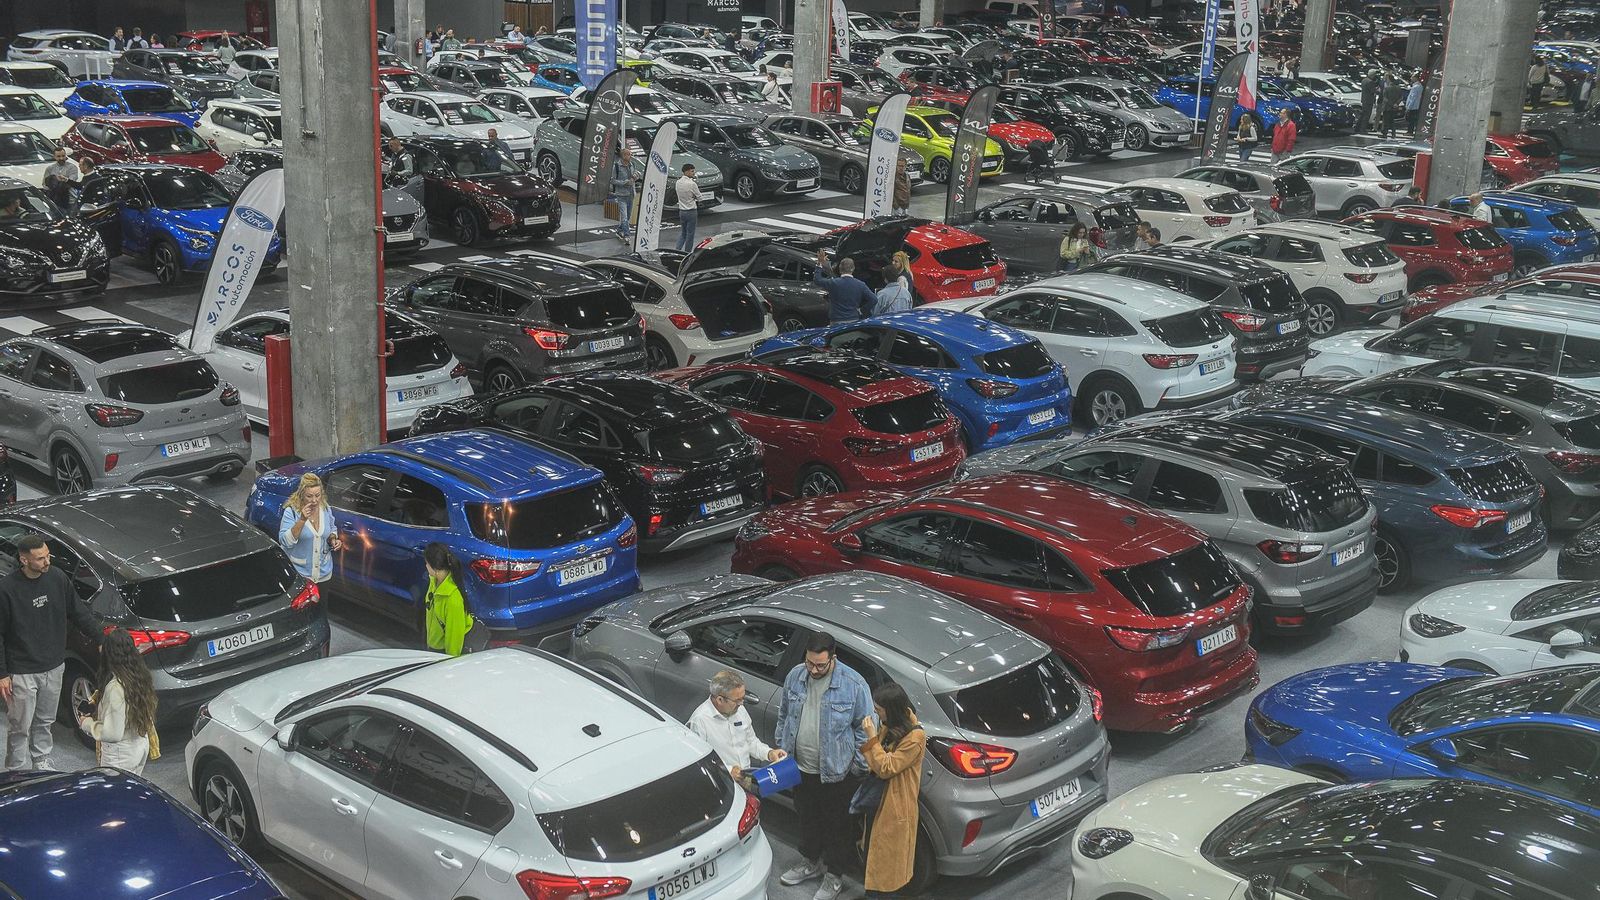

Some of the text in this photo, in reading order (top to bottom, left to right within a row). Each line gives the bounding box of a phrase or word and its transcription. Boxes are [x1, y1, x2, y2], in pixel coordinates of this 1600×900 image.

[597, 96, 624, 109] NISSAN
[1422, 88, 1440, 134] MARCOS
[880, 128, 894, 140] Ford
[1208, 107, 1226, 158] MARCOS
[586, 124, 607, 184] MARCOS
[870, 156, 885, 220] MARCOS
[956, 143, 972, 203] MARCOS
[241, 209, 267, 229] Ford
[640, 182, 656, 249] MARCOS
[207, 243, 245, 326] MARCOS
[230, 250, 256, 306] automoción
[167, 438, 207, 454] 8819 MLF
[706, 499, 725, 511] 5486
[563, 566, 586, 580] 0686
[217, 626, 270, 651] 4060 LDY
[1203, 634, 1220, 651] 0211
[1039, 780, 1078, 810] 5074 LZN
[657, 861, 716, 900] 3056 LWJ
